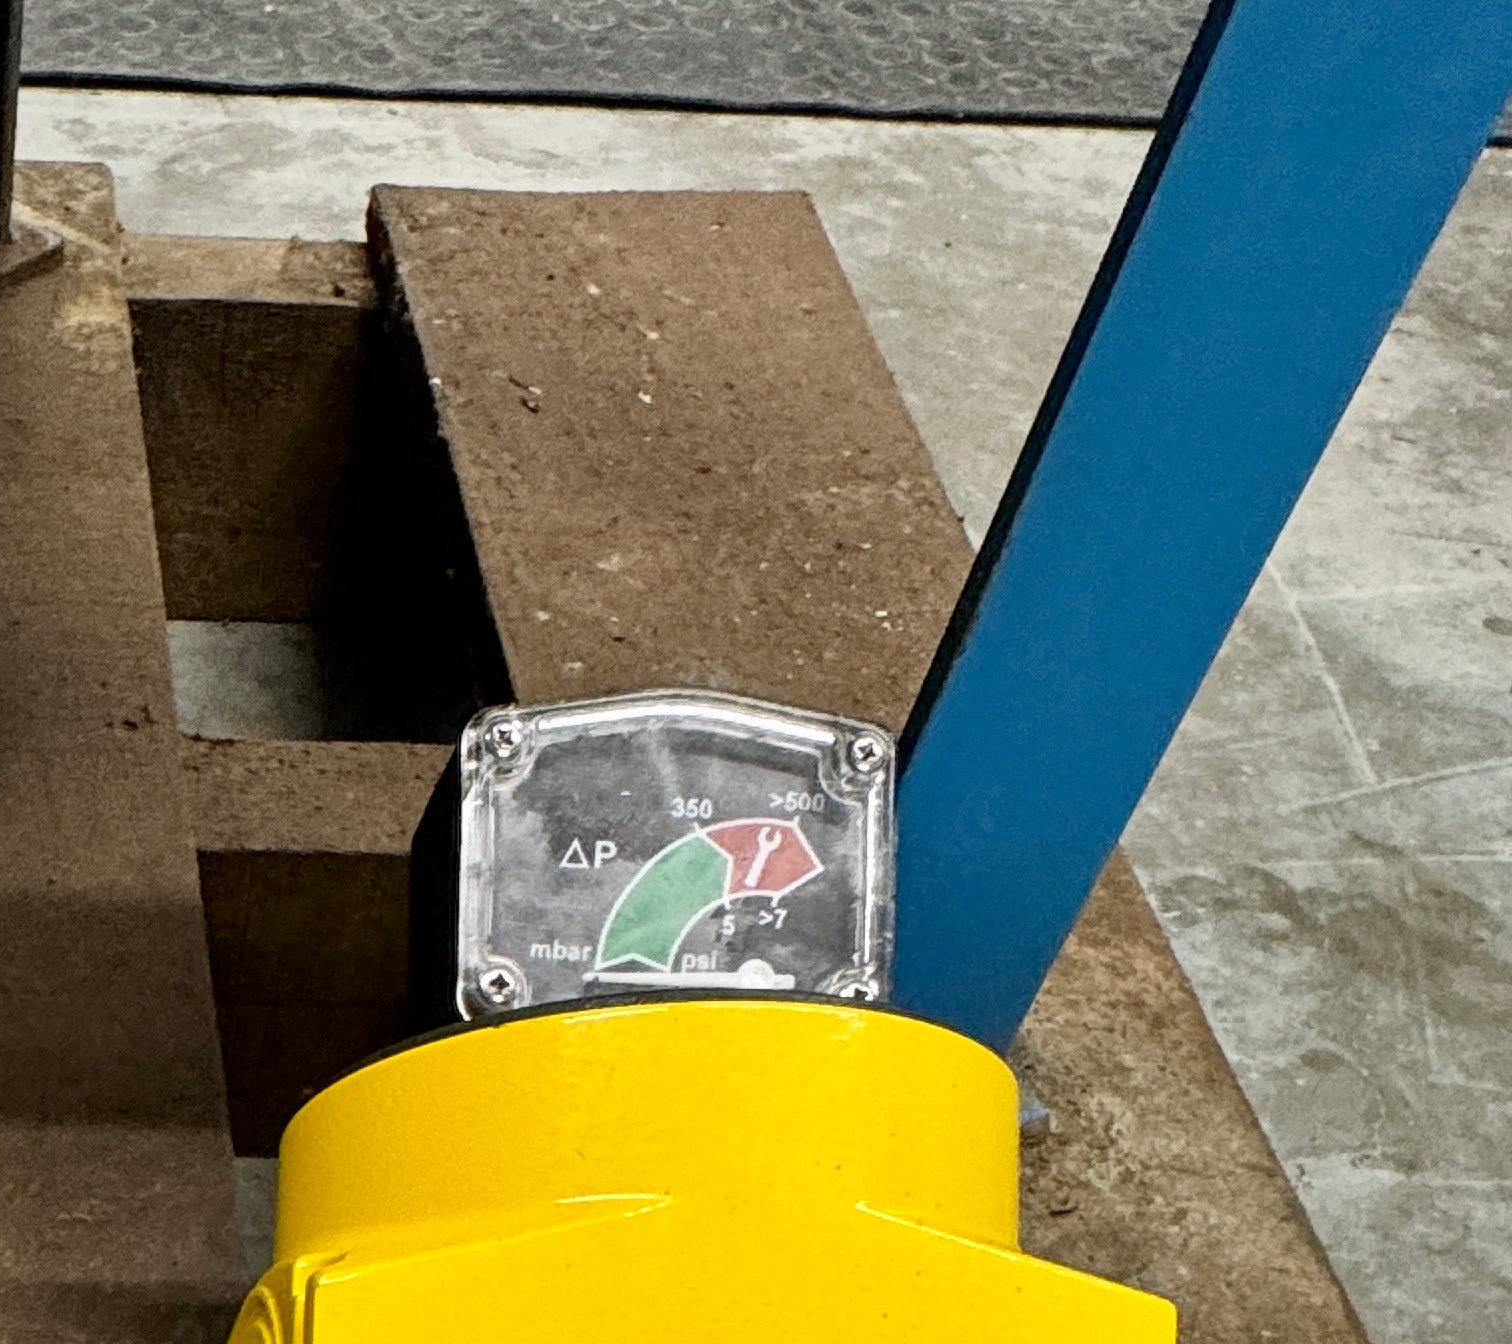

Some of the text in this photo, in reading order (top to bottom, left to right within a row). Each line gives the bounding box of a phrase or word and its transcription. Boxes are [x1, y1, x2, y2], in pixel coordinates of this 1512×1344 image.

[670, 798, 712, 820] 350
[769, 792, 825, 812] >500
[722, 913, 736, 936] 5
[758, 908, 787, 930] >7
[530, 938, 592, 962] mbar
[681, 950, 718, 973] psi
